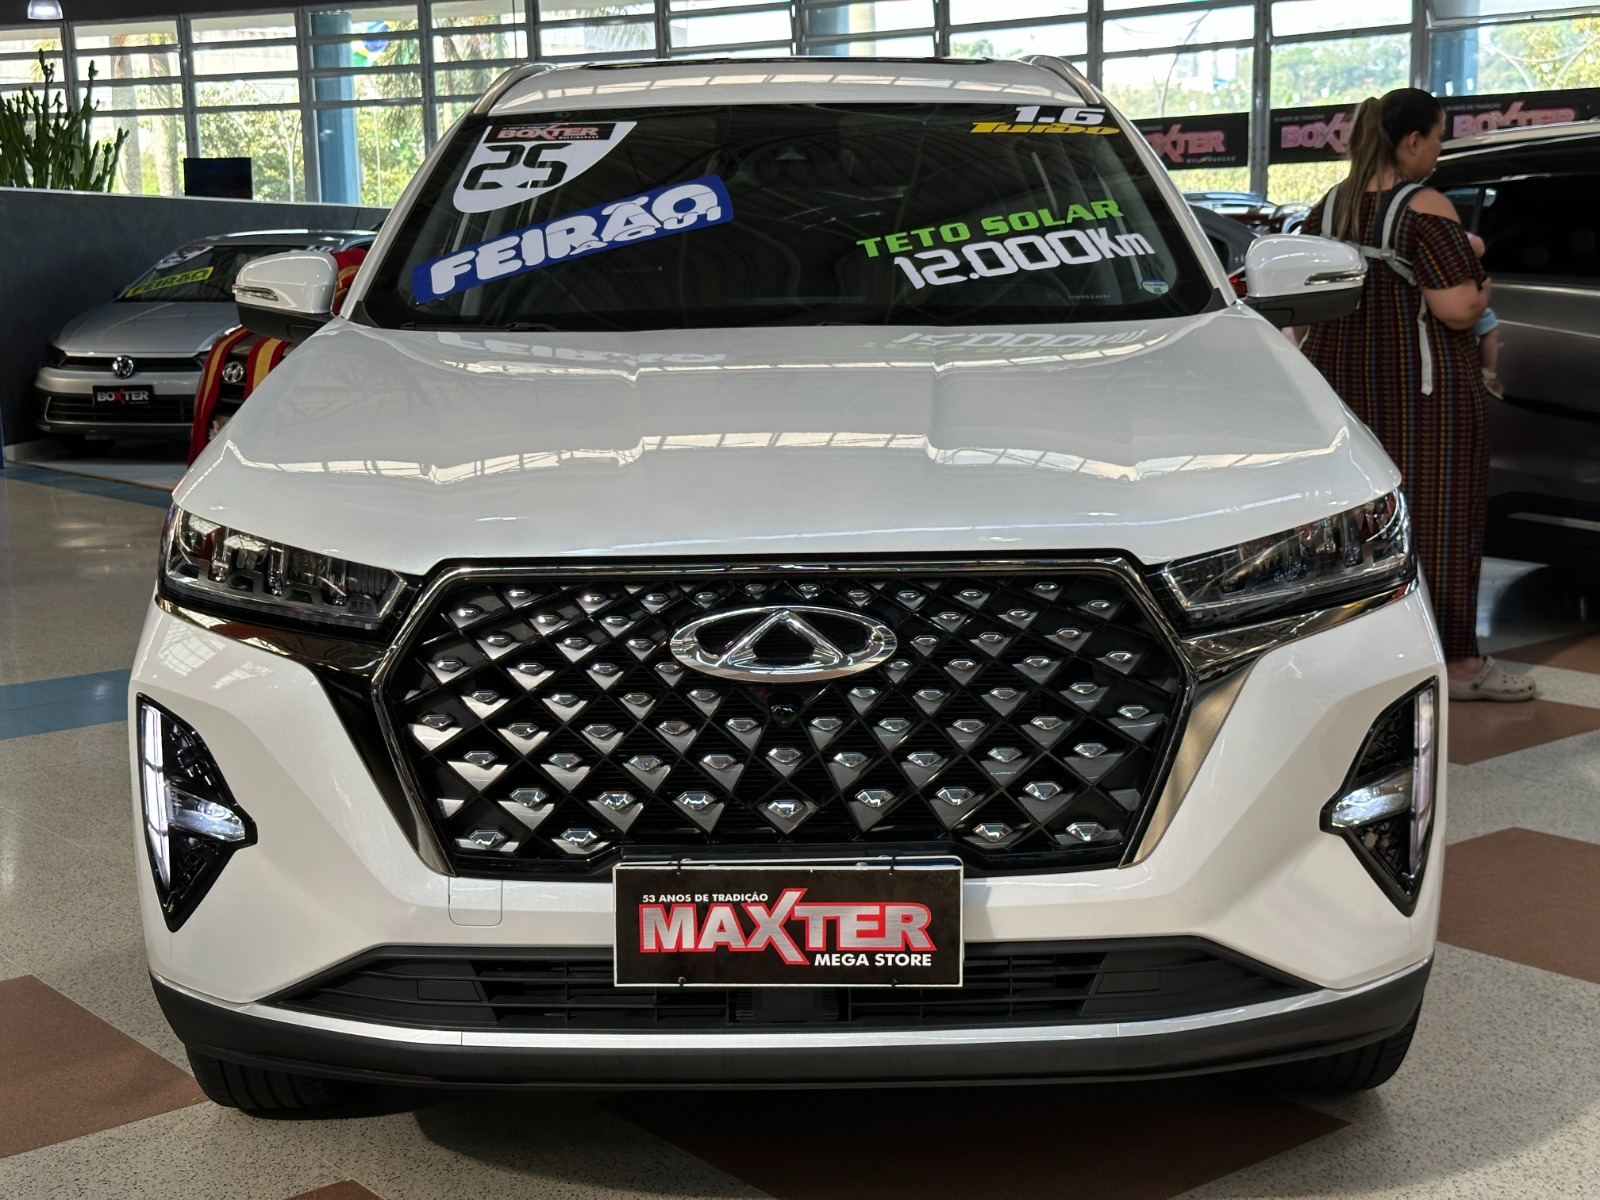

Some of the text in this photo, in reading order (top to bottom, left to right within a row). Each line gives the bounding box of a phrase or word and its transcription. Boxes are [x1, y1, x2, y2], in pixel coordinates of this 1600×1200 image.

[1015, 106, 1105, 125] 1.6
[497, 123, 600, 140] BOXTER
[970, 122, 1120, 135] Turbo
[462, 143, 572, 191] 25
[856, 200, 1124, 258] TETO SOLAR
[430, 184, 719, 295] FEIRÃO
[894, 227, 1156, 290] 12.000Km
[97, 388, 150, 405] BOXTER
[642, 891, 769, 904] 53 ANOS DE TRADIÇÃO
[639, 888, 937, 965] MAXTER
[814, 953, 932, 966] MEGA STORE
